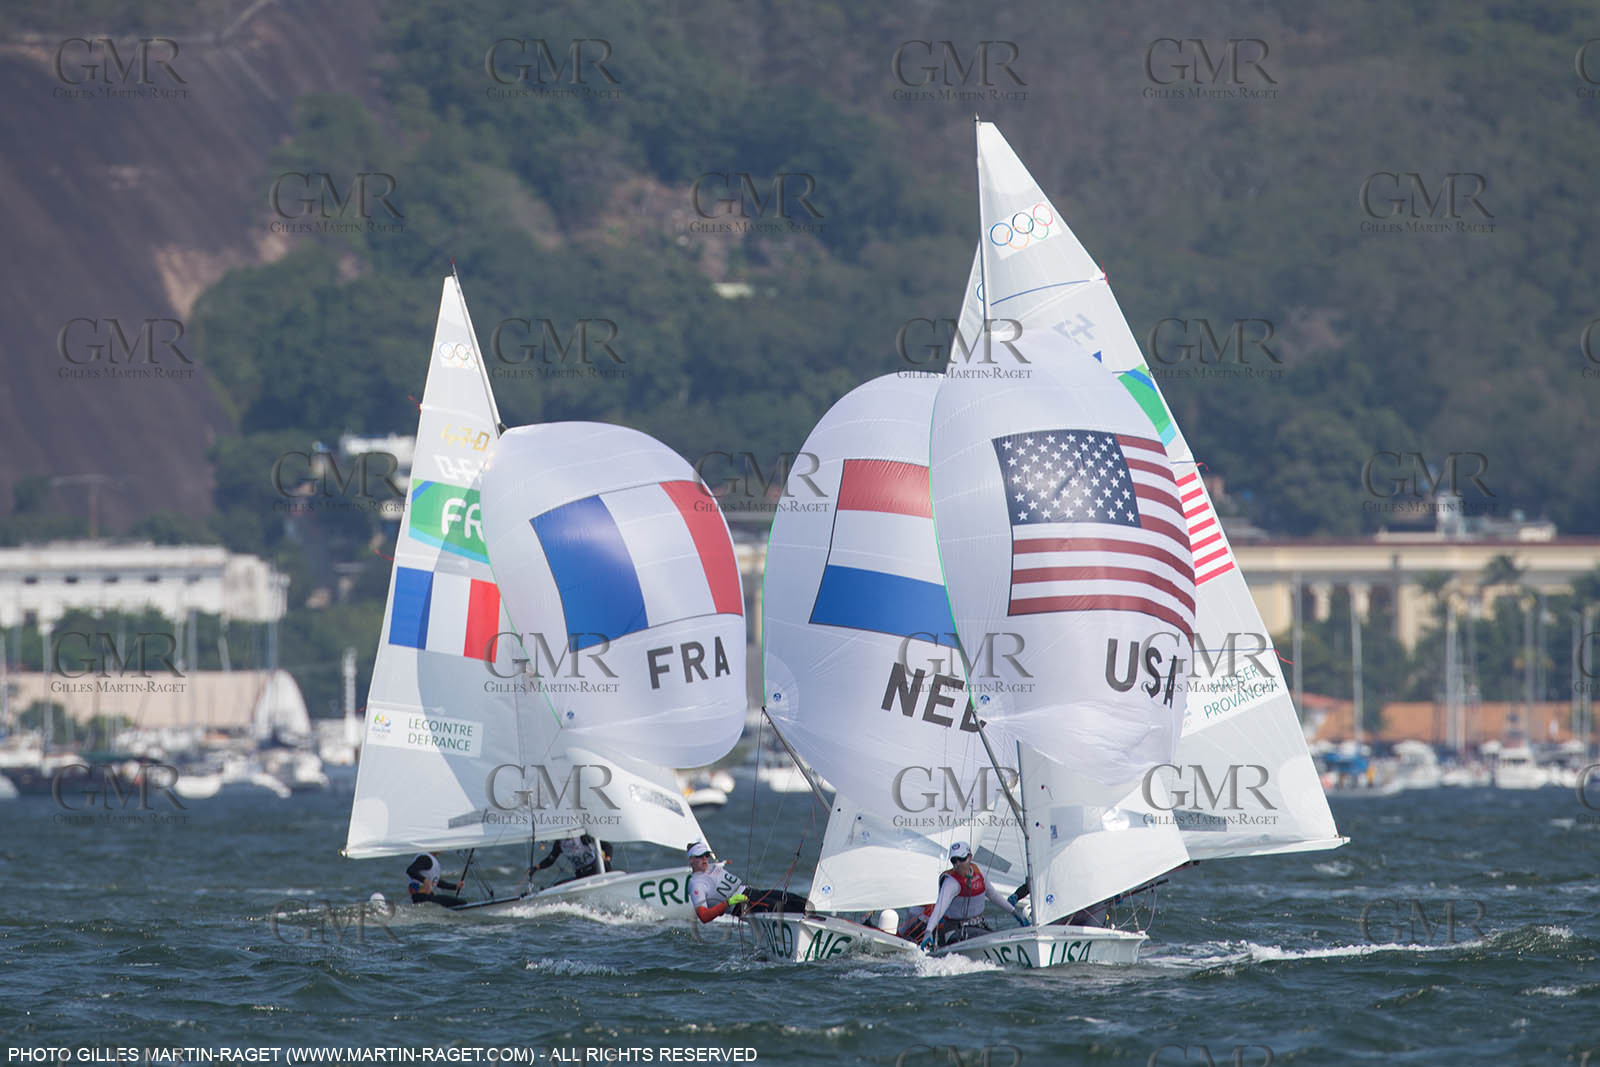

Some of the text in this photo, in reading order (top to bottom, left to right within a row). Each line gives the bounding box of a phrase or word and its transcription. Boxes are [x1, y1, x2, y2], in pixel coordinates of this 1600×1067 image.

[441, 498, 482, 543] FR
[647, 635, 731, 690] FRA
[1105, 637, 1178, 709] USA
[408, 717, 473, 737] LECOINTRE
[407, 733, 471, 752] DEFRANCE
[716, 872, 738, 898] NE
[805, 929, 853, 961] NE
[1048, 940, 1093, 966] USA
